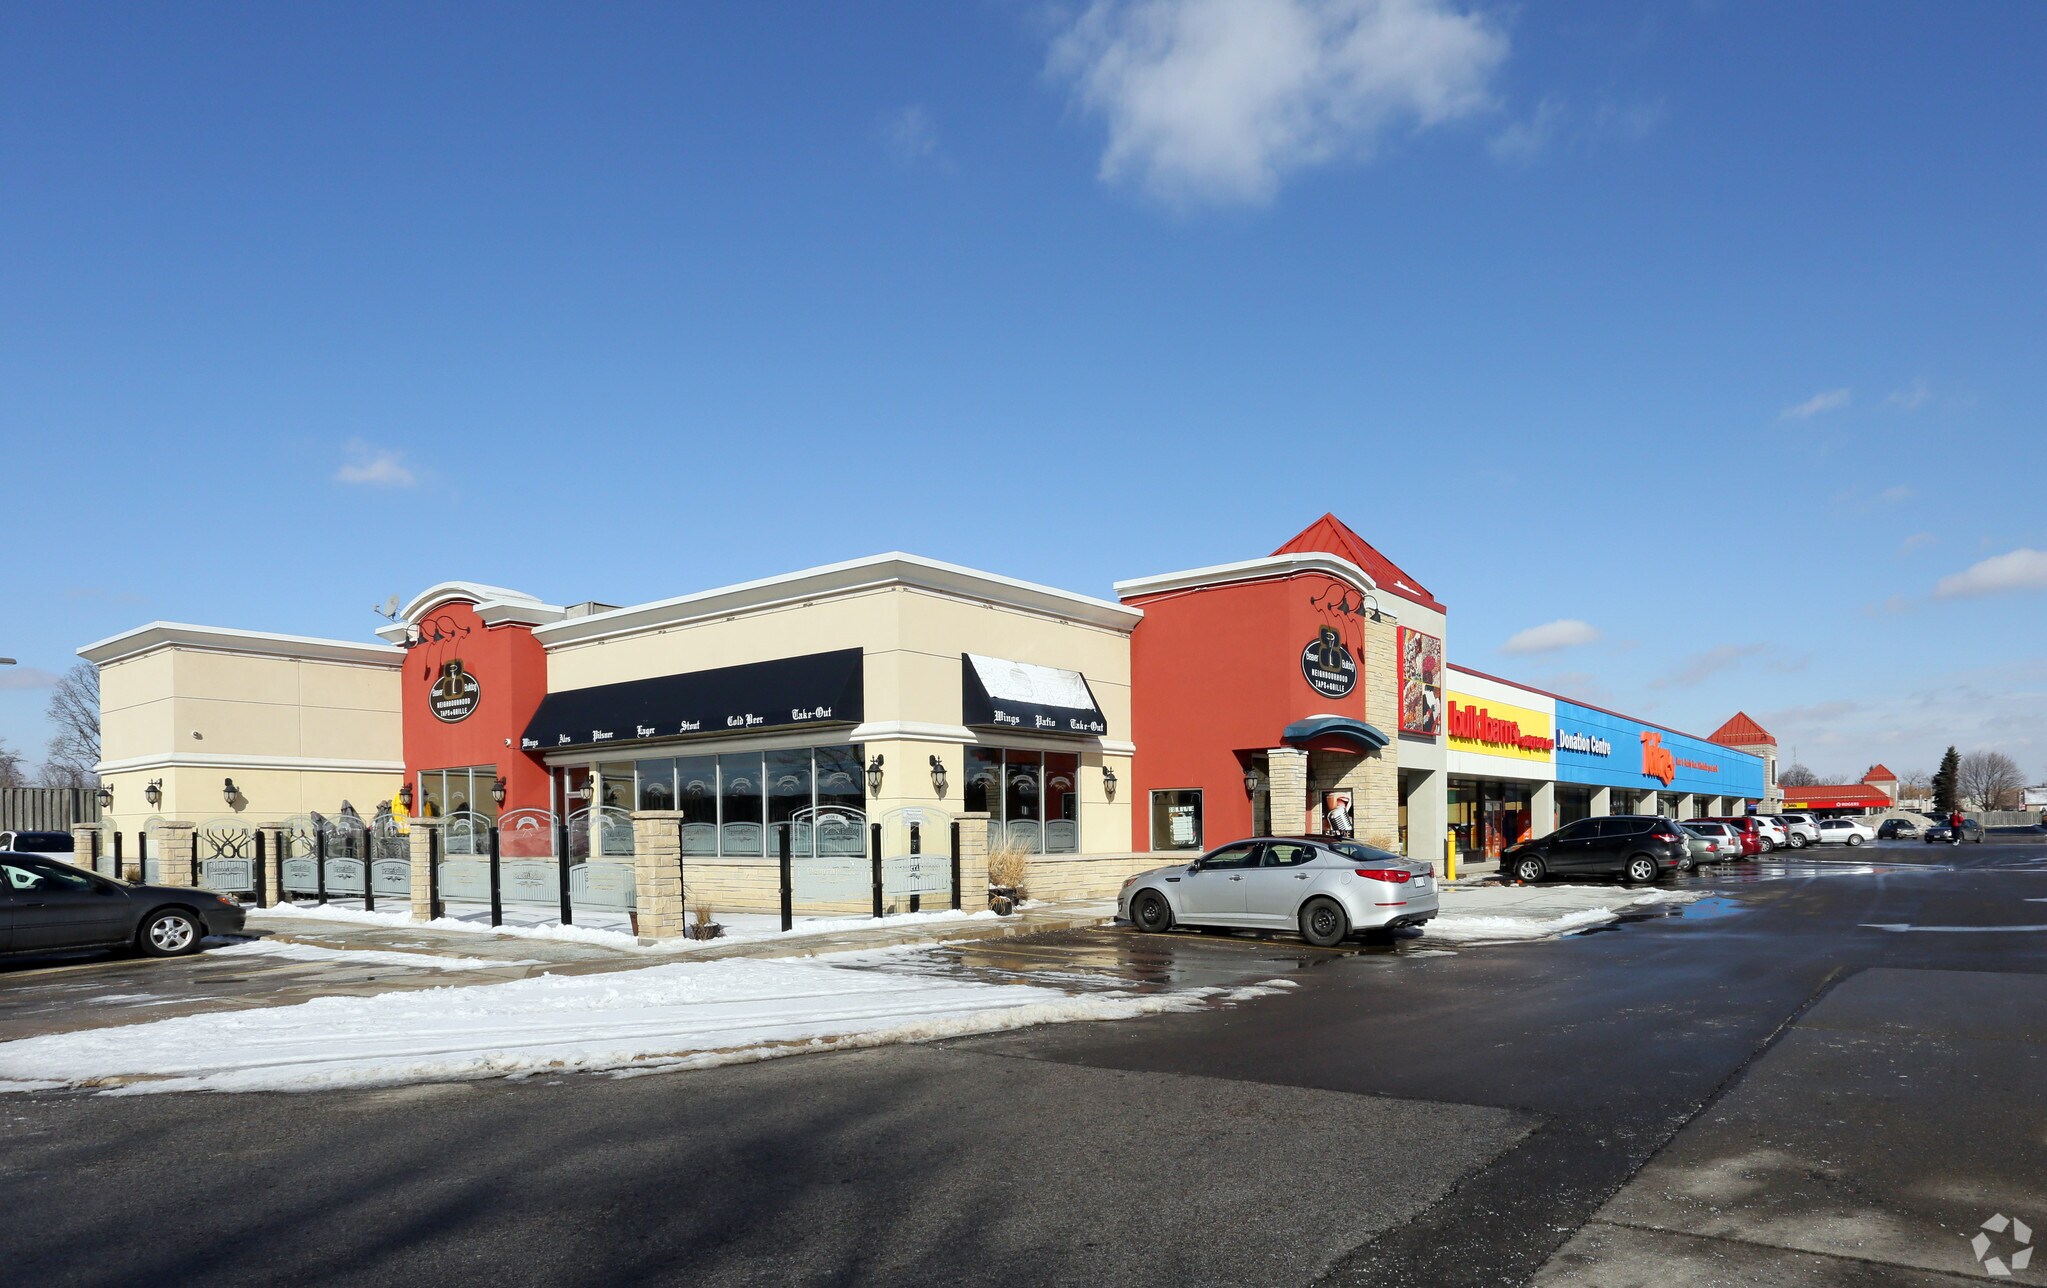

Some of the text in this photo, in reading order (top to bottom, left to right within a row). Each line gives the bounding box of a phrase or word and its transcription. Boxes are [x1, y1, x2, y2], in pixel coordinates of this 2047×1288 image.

[1311, 668, 1348, 683] NEIGHBOURHOOD
[522, 706, 832, 749] Wings Ales Pilsner Lager Stout Cold Beer Take-Out
[993, 710, 1104, 732] Wings Patio Take-Out
[1448, 700, 1480, 740] bulk
[1480, 708, 1513, 745] barn
[1557, 728, 1591, 752] Donation
[1591, 735, 1611, 756] Centre
